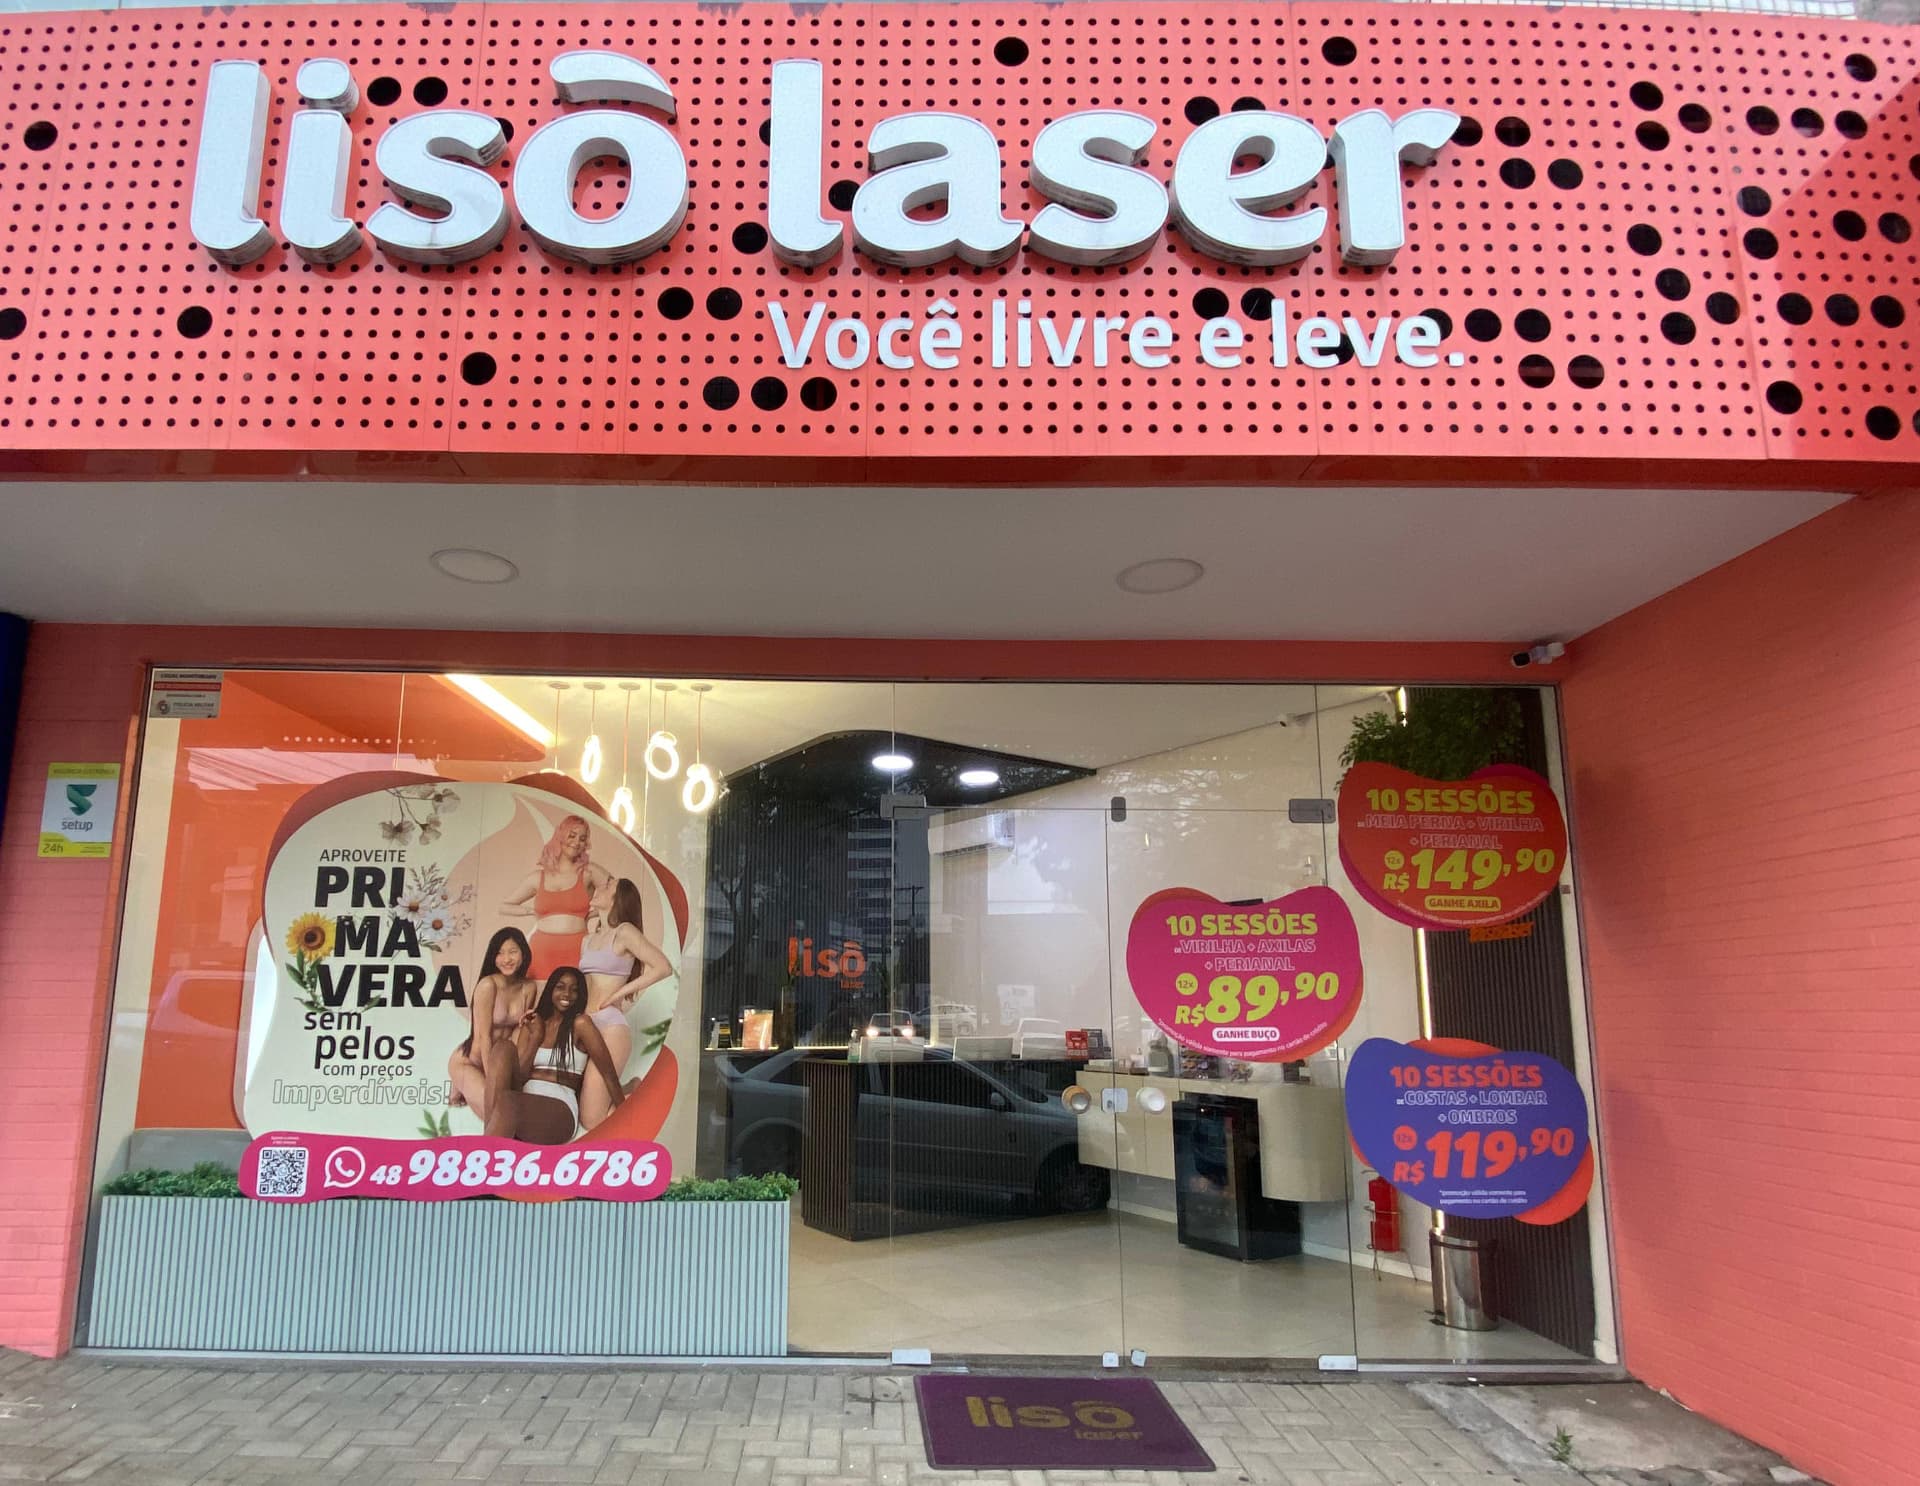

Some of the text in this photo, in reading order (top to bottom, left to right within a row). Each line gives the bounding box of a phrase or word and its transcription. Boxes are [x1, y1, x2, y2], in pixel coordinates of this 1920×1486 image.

[767, 58, 1462, 268] laser
[767, 297, 1465, 370] Você livre e leve.
[1366, 784, 1536, 814] 10 SESSÕES
[61, 820, 93, 832] setup
[1365, 814, 1408, 829] MEIA
[1409, 815, 1466, 830] PERNA
[1476, 816, 1544, 832] VIRILHA
[42, 843, 64, 854] 24h
[1420, 834, 1503, 849] PERIANAL
[320, 849, 406, 862] APROVEITE
[1383, 848, 1556, 893] R$ 149,90
[314, 866, 406, 908] PRI
[1429, 898, 1499, 909] GANHE AXILA
[1166, 908, 1319, 937] 10 SESSÕES
[333, 915, 422, 958] MA
[1180, 938, 1246, 954] VIRILHA
[1256, 939, 1316, 953] AXILAS
[1214, 956, 1296, 972] PERIANAL
[317, 964, 468, 1008] VERA
[1178, 979, 1194, 989] 12x
[1175, 971, 1340, 1028] R$ 89,90
[304, 1011, 362, 1031] sem
[314, 1026, 415, 1069] pelos
[1216, 1029, 1277, 1042] GANHE BUÇO
[323, 1063, 413, 1080] com preços
[1390, 1060, 1543, 1088] 10 SESSÕES
[272, 1078, 454, 1111] Imperdíveis!
[1404, 1090, 1468, 1105] COSTAS
[1479, 1090, 1548, 1105] LOMBAR
[1447, 1109, 1518, 1124] OMBROS
[1393, 1127, 1575, 1185] R$ 119,90
[369, 1149, 659, 1188] 48 98836.6786
